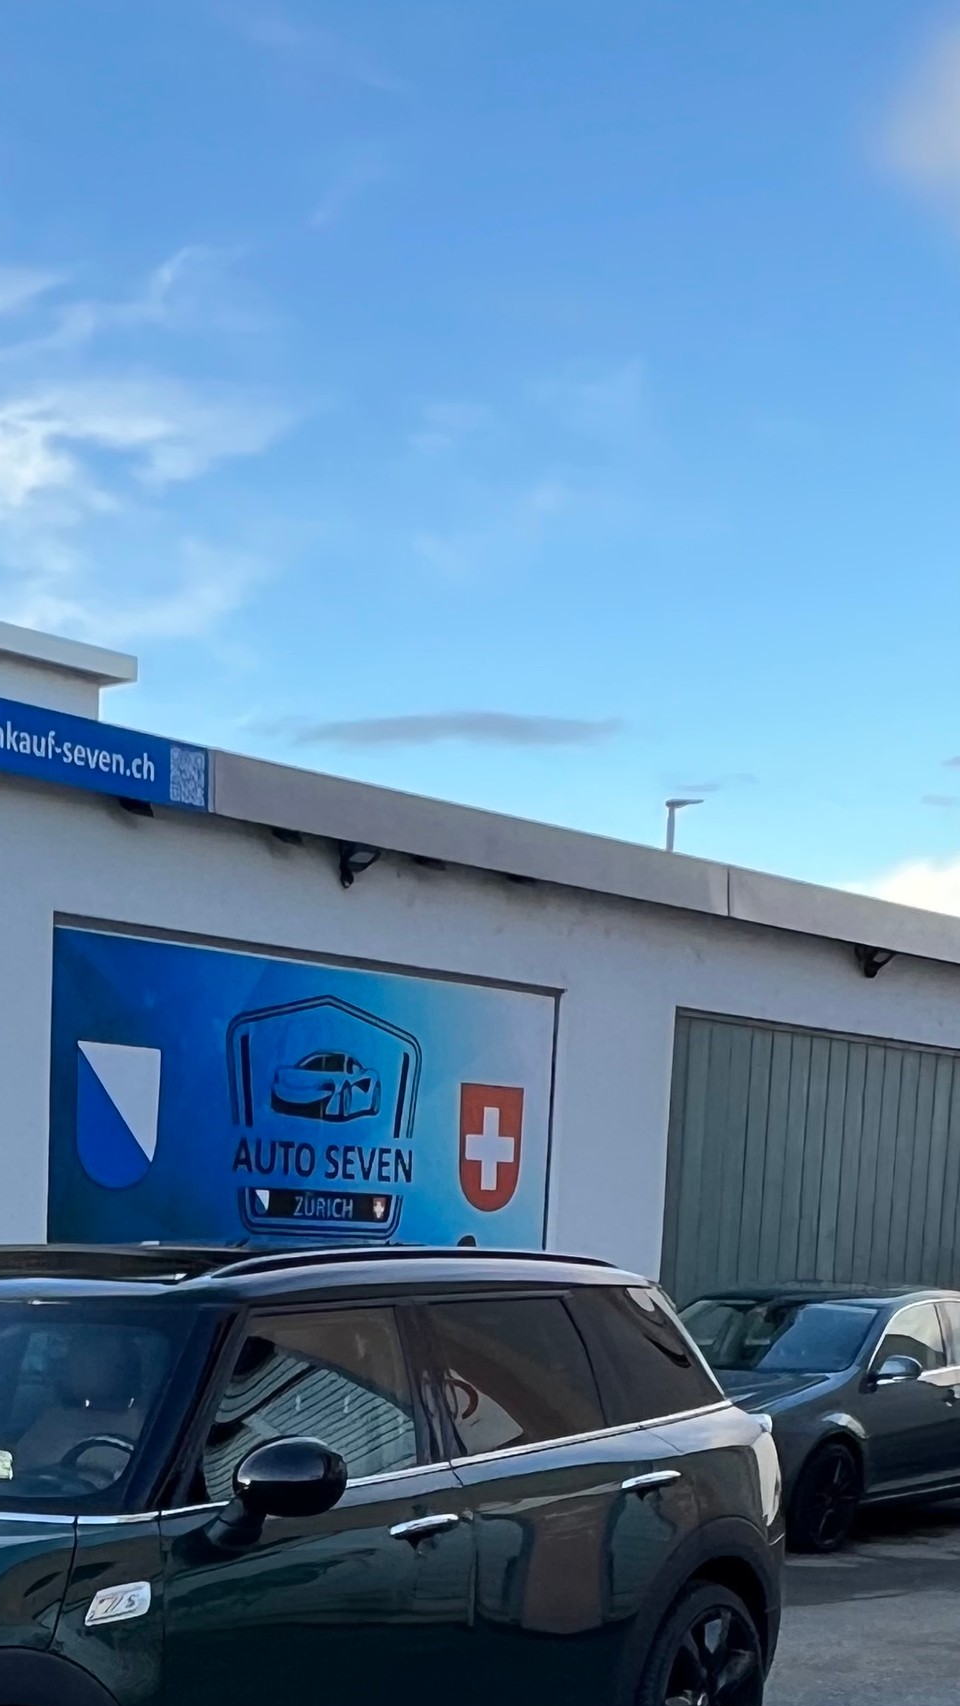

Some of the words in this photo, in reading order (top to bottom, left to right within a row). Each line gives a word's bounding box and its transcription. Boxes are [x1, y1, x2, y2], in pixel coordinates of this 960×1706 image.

[232, 1136, 315, 1177] AUTO
[324, 1144, 413, 1183] SEVEN
[293, 1191, 354, 1219] ZÜRICH
